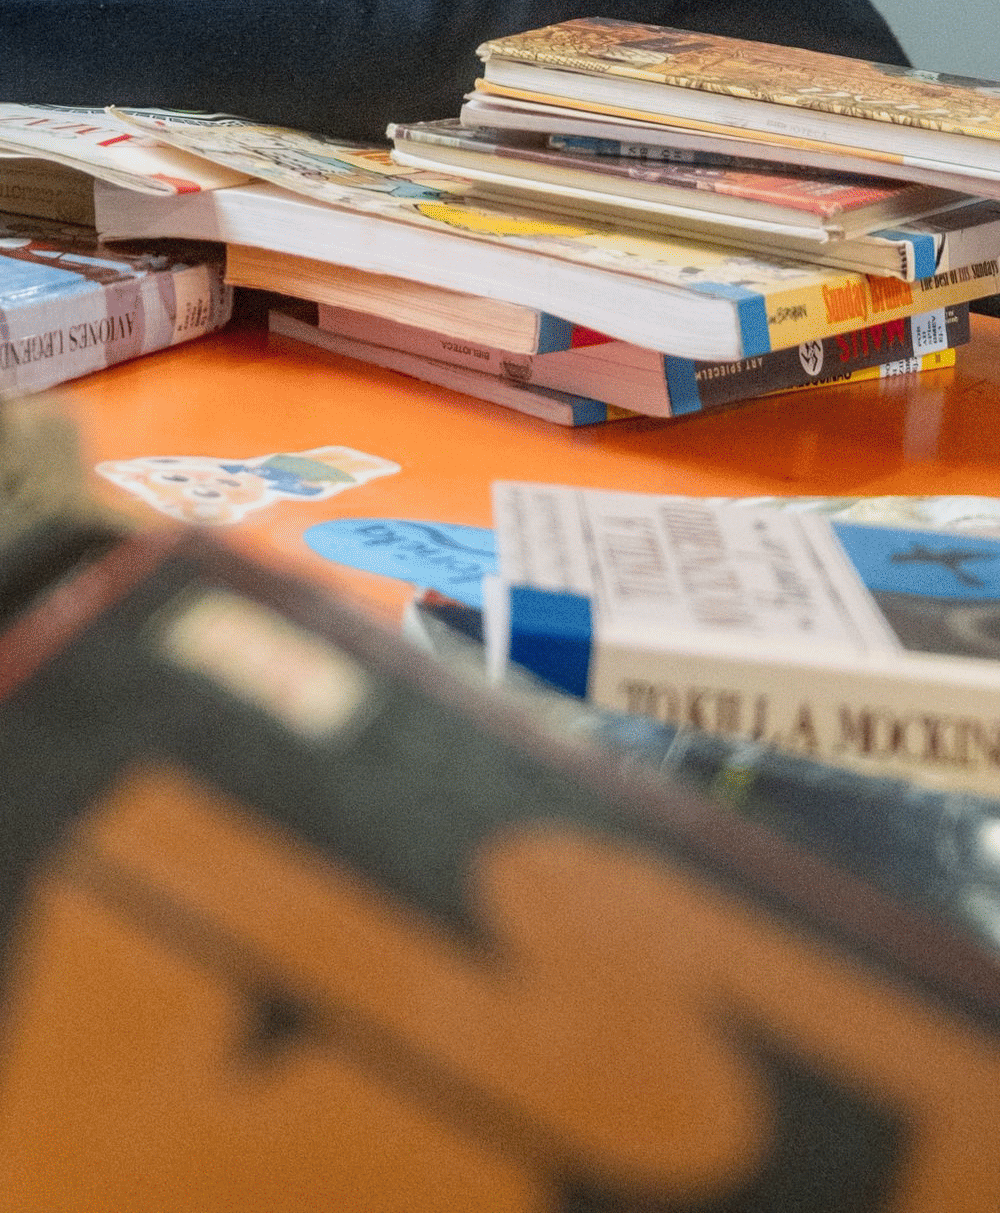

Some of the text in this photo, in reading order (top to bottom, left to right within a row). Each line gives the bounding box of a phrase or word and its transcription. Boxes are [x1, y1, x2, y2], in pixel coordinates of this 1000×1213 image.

[69, 312, 136, 353] AVIONES
[834, 316, 907, 363] MAUS
[440, 340, 491, 361] BIBLIOTECA
[745, 357, 764, 371] ART
